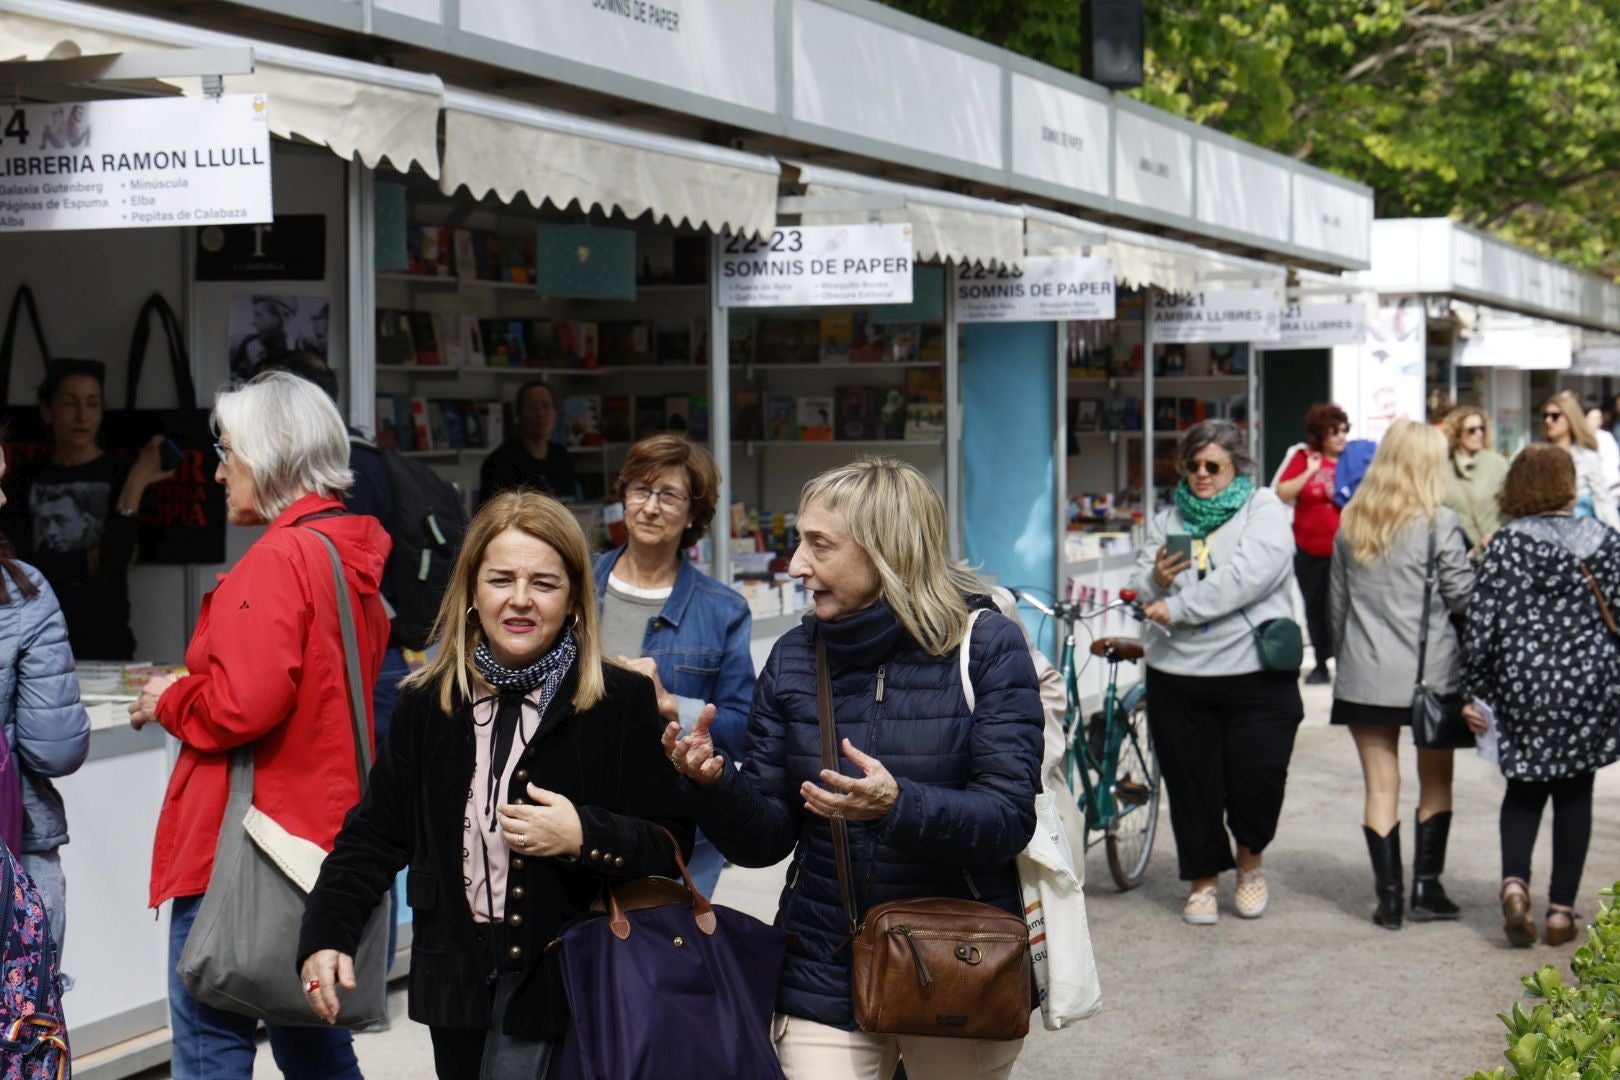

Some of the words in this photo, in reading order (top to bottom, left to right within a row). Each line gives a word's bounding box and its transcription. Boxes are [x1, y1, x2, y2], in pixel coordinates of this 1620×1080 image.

[0, 108, 30, 146] 4
[102, 151, 187, 172] RAMON
[195, 147, 265, 168] LLULL
[42, 182, 104, 195] Gutenberg
[130, 177, 189, 190] Minúscula
[46, 198, 60, 210] de
[63, 198, 110, 211] Espuma
[130, 195, 156, 207] Elba
[131, 211, 174, 223] Pepitas
[177, 210, 191, 220] de
[194, 208, 248, 220] Calabaza
[723, 259, 804, 278] SOMNIS
[811, 258, 837, 275] DE
[843, 256, 909, 275] PAPER
[958, 284, 1025, 299] SOMNIS
[1030, 283, 1052, 297] DE
[1057, 281, 1112, 296] PAPER
[1155, 310, 1202, 323] AMBRA
[1206, 308, 1263, 322] LLIBRES
